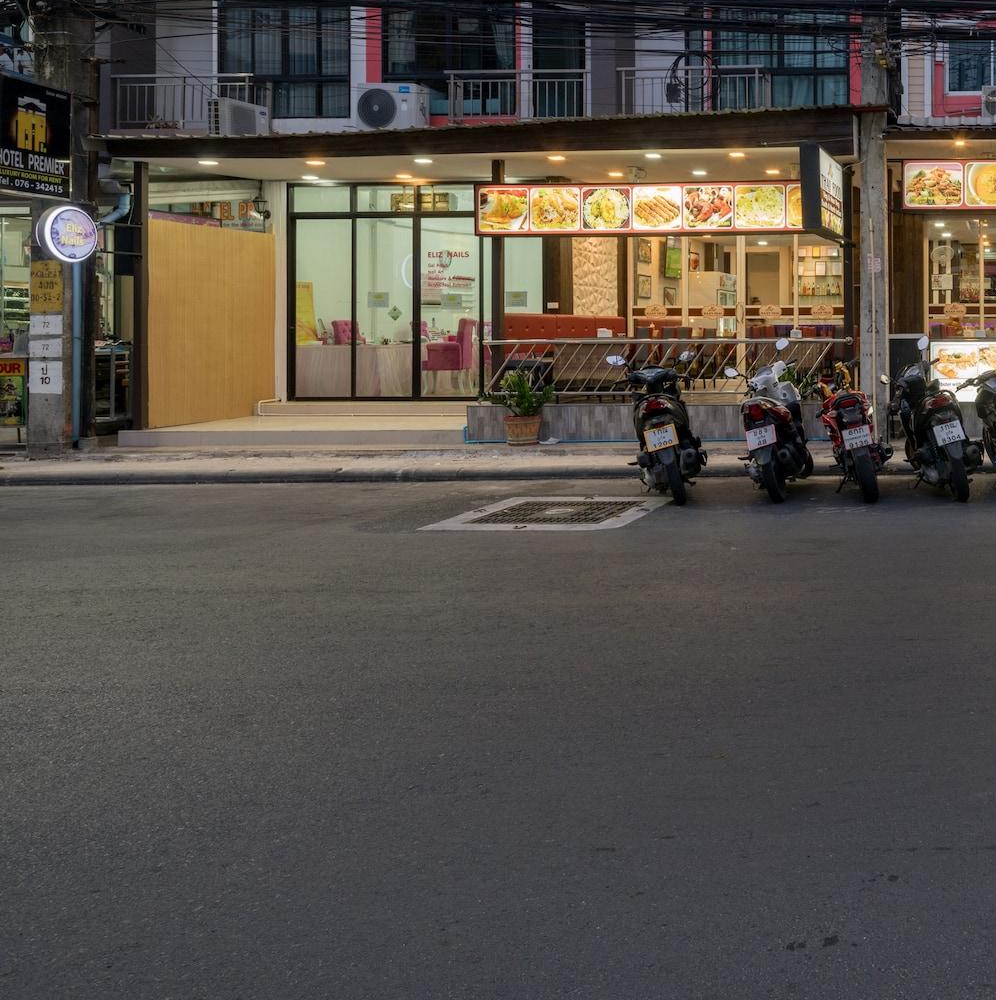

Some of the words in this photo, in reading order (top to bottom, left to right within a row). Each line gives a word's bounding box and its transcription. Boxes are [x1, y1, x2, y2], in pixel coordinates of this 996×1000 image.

[28, 153, 65, 176] PREMIER
[23, 171, 37, 180] ROOM
[15, 178, 29, 188] 076
[36, 182, 64, 194] 342415
[65, 223, 82, 233] Eliz
[61, 235, 84, 246] Nails
[40, 376, 51, 385] 10
